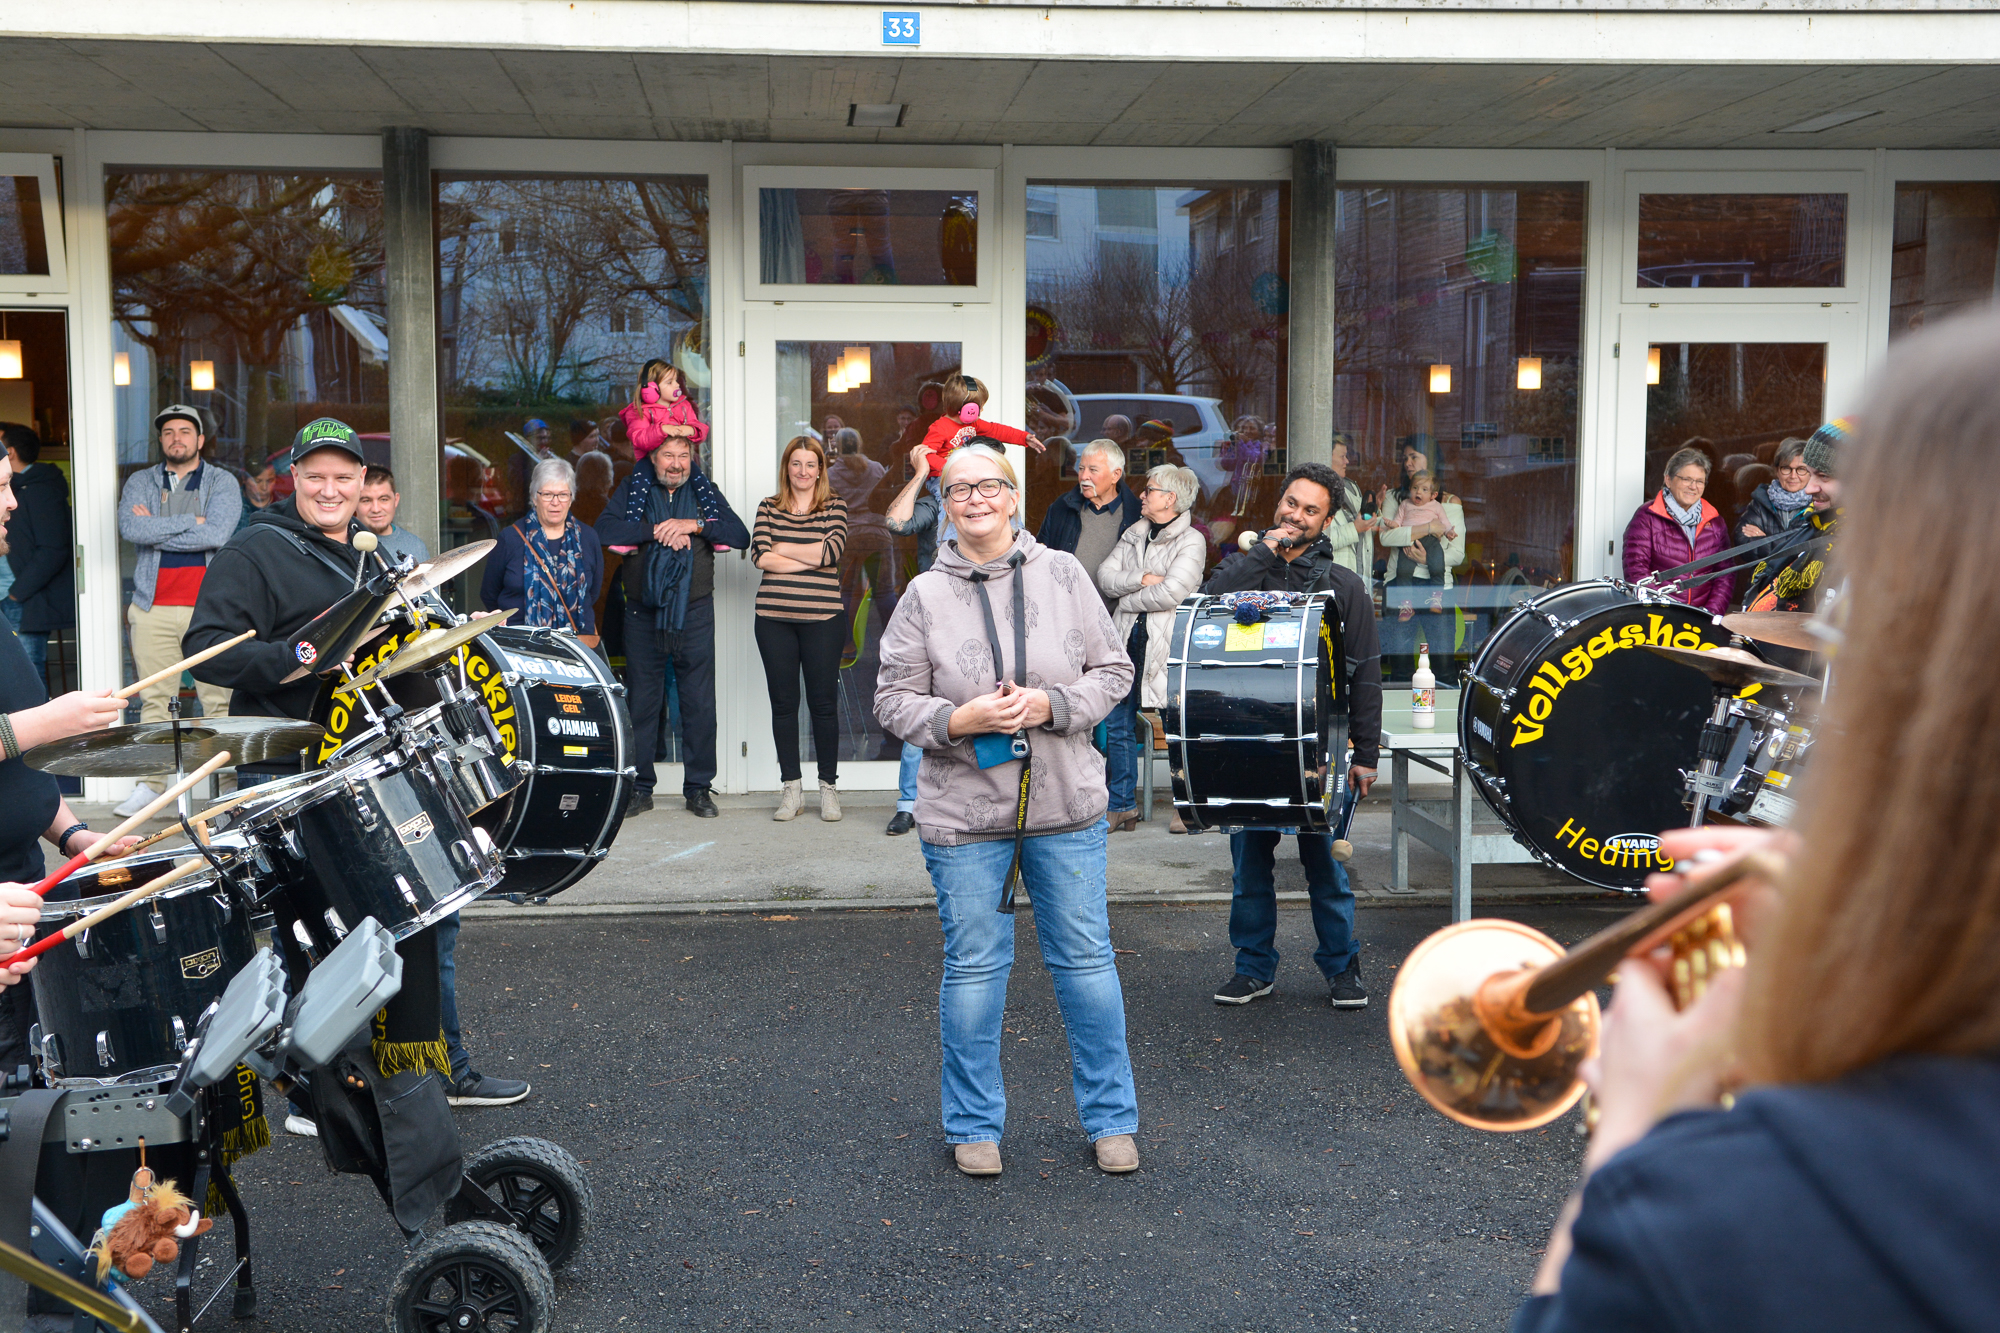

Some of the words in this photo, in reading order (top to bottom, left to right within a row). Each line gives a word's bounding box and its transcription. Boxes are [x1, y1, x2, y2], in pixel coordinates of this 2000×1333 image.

[888, 17, 915, 38] 33
[302, 421, 353, 445] FOX
[1510, 613, 1763, 748] Vollgashöl
[554, 693, 582, 704] LEIDER
[562, 704, 581, 714] GEIL
[559, 719, 600, 738] YAMAHA
[1555, 817, 1675, 872] Heding
[1612, 838, 1659, 849] EVANS
